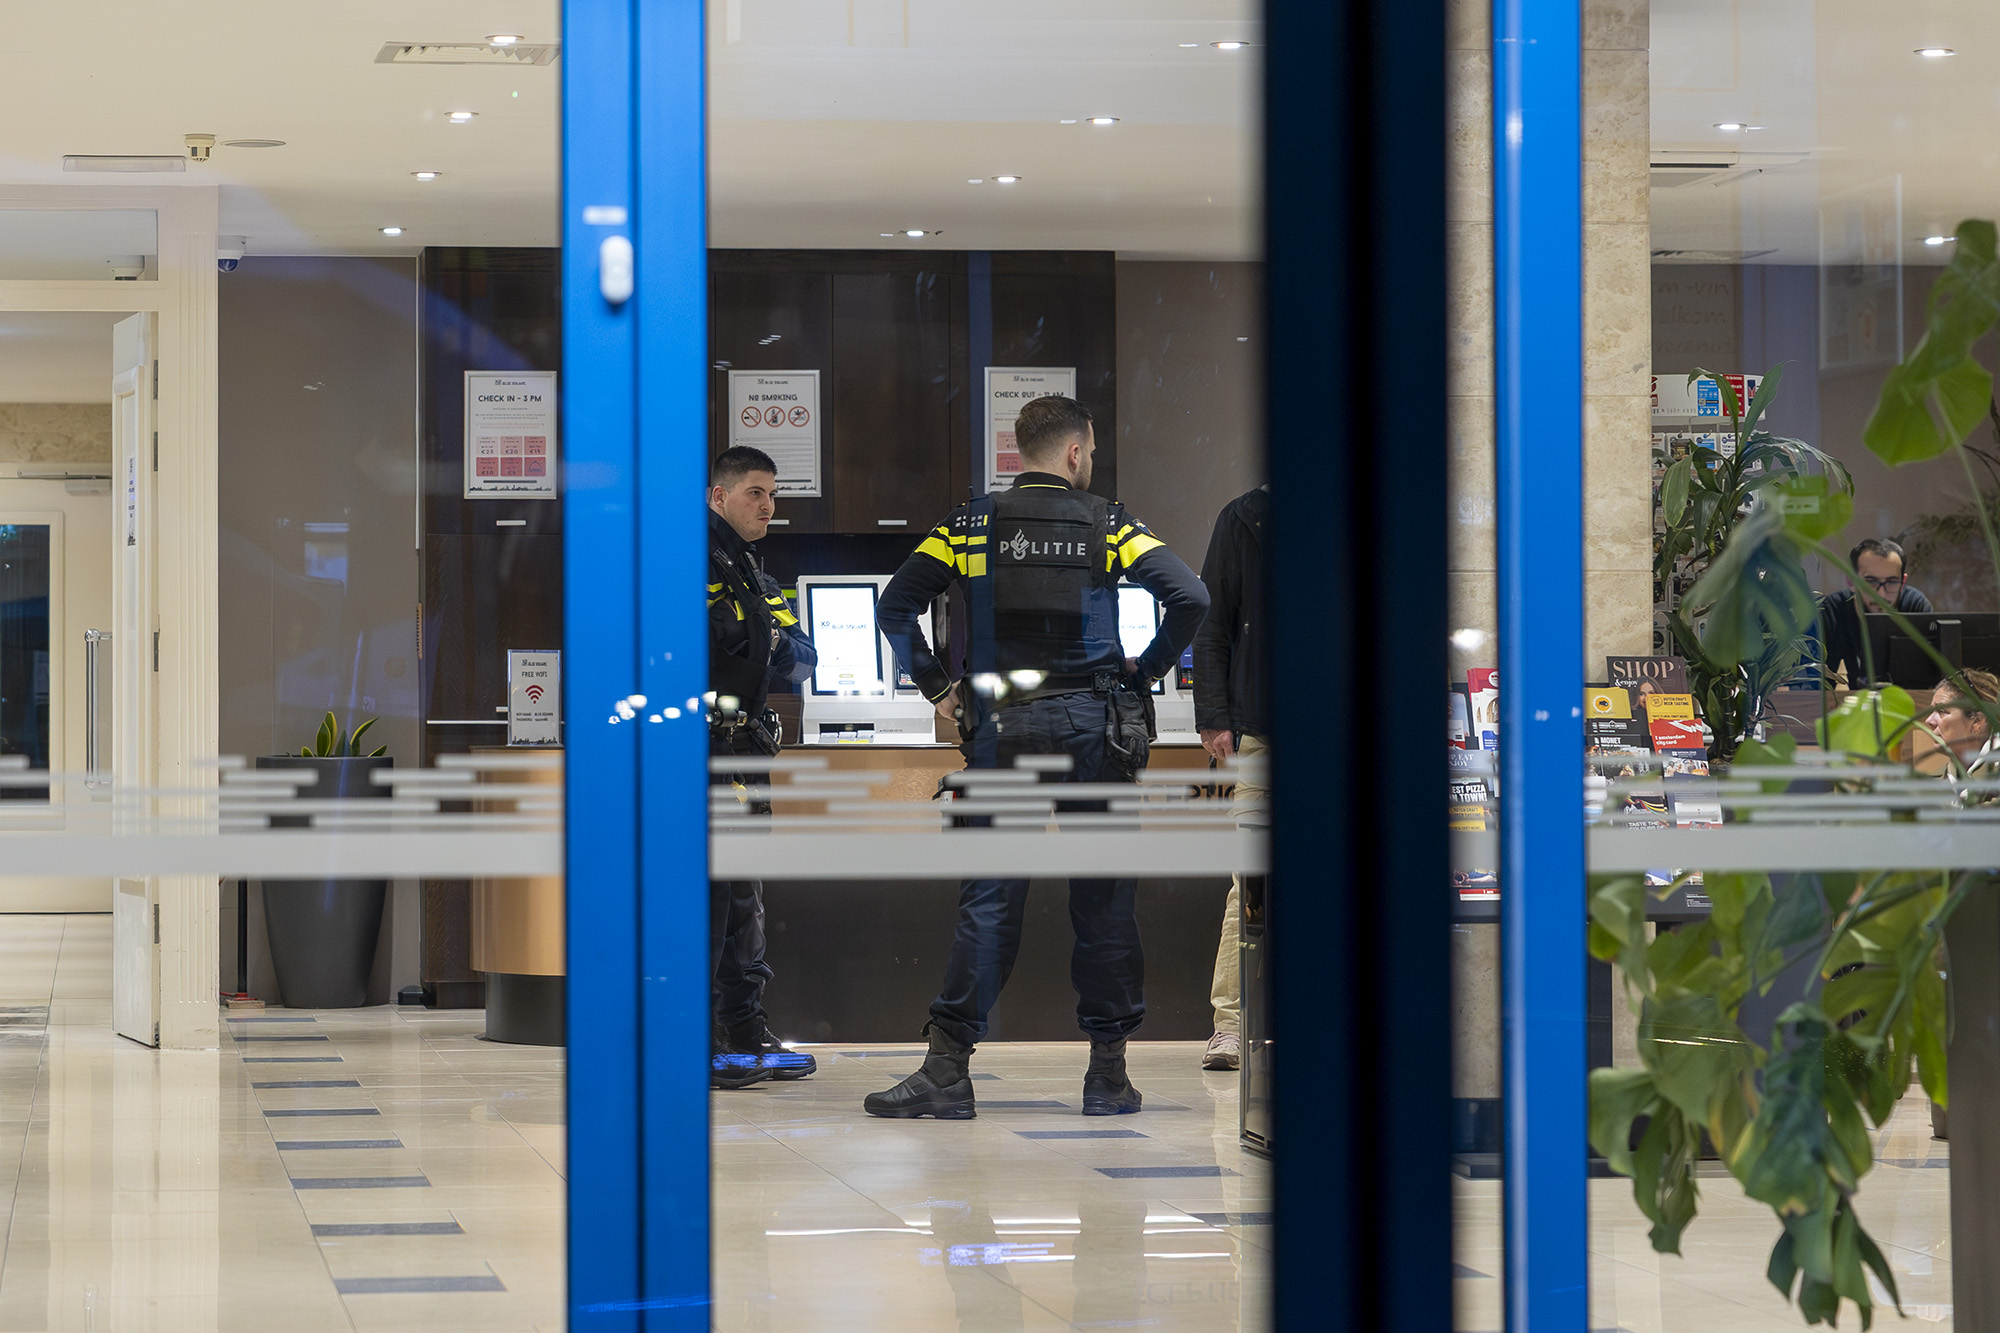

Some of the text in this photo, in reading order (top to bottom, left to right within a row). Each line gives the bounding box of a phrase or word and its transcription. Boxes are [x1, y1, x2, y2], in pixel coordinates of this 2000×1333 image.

[1000, 534, 1086, 560] POLITIE
[1612, 660, 1675, 679] SHOP
[1600, 736, 1621, 744] MONET
[1451, 784, 1486, 794] EST PIZZA
[1459, 792, 1488, 802] TOWN!
